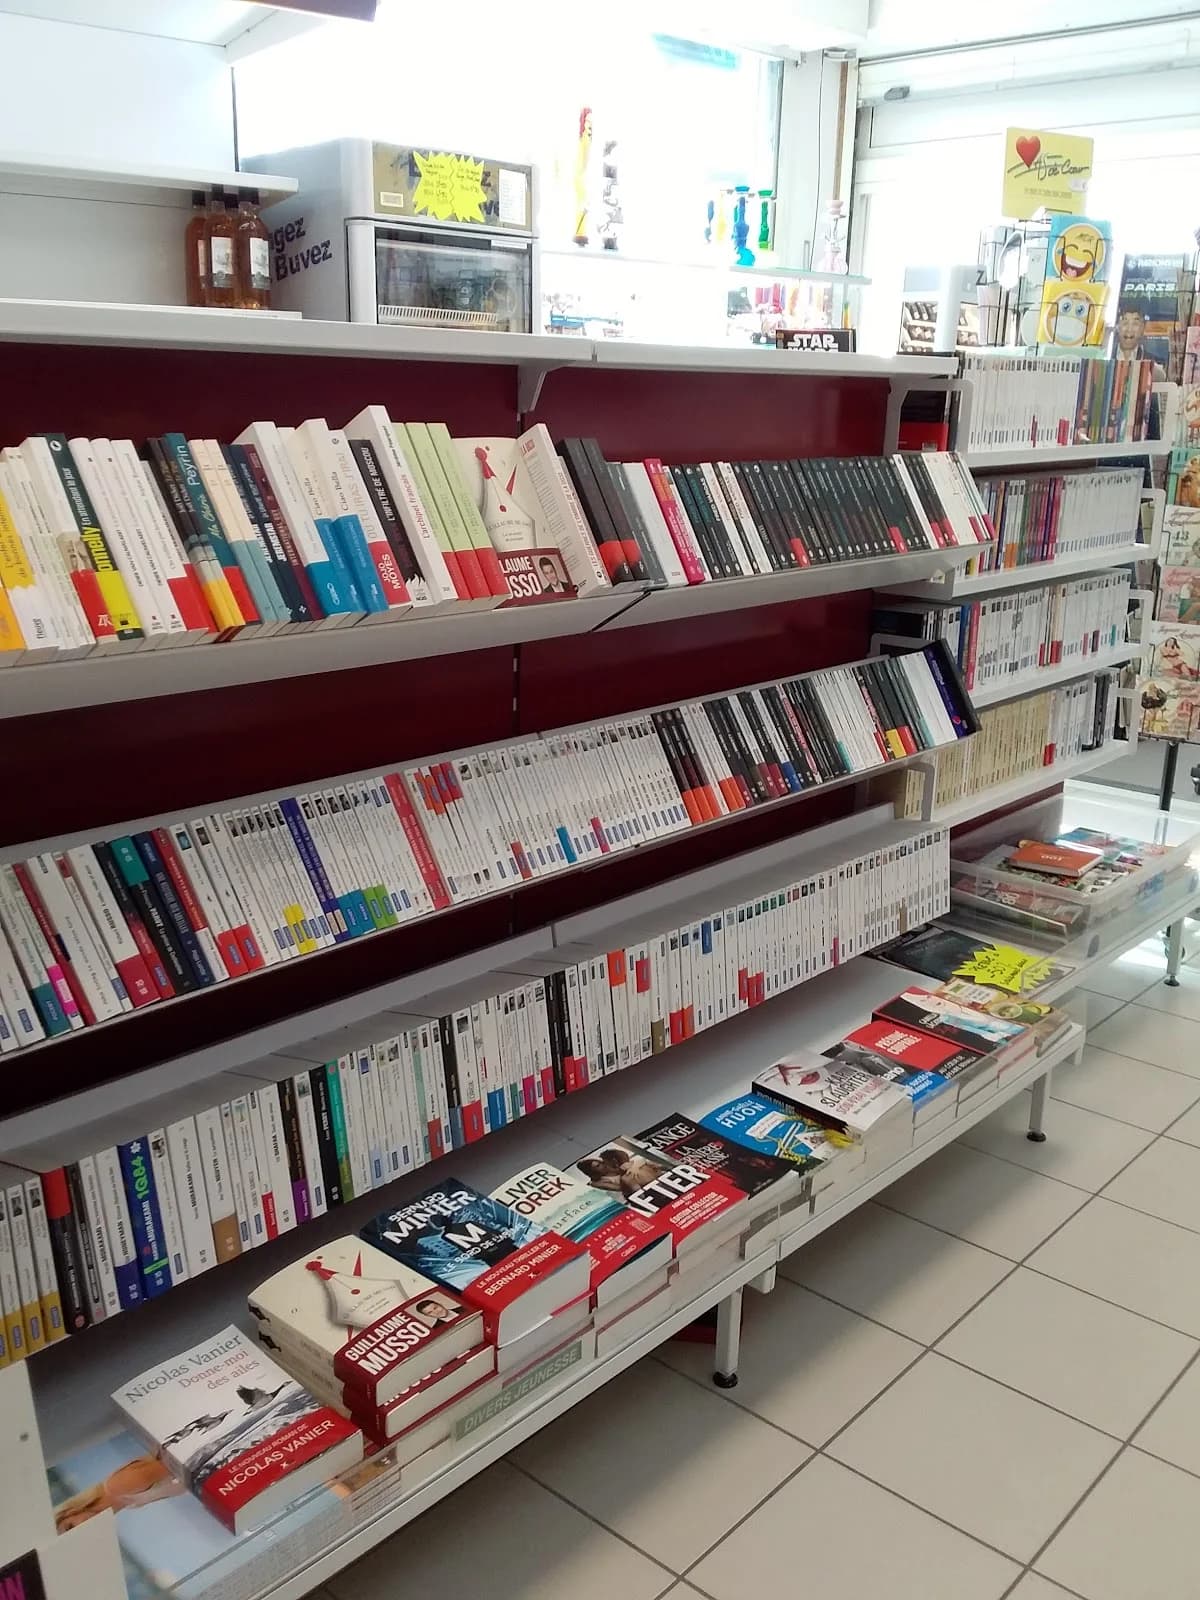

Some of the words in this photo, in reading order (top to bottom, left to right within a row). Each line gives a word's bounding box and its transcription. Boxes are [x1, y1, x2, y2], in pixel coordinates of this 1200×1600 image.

[275, 239, 333, 281] Buvez
[1124, 283, 1177, 292] PARIS
[787, 333, 839, 349] STAR
[60, 465, 74, 481] jour
[175, 443, 201, 486] Peyrin
[361, 445, 378, 476] MOSCOU
[330, 470, 341, 490] Bella
[372, 475, 382, 487] DE
[69, 486, 87, 516] attendant
[337, 490, 349, 511] Ciao
[79, 515, 91, 527] En
[411, 504, 430, 539] L'archipel
[82, 523, 114, 574] onnelly
[501, 554, 534, 573] LAUME
[378, 562, 390, 583] JOJO
[382, 553, 400, 588] MOYES
[820, 1071, 873, 1108] SLAUGHTER
[720, 1102, 768, 1129] HUON
[131, 1155, 148, 1198] 1Q84
[495, 1168, 556, 1208] LIVIER
[389, 1191, 445, 1223] BERNARD
[516, 1177, 575, 1216] OREK
[142, 1200, 155, 1240] MURAKAMI
[381, 1189, 477, 1245] MINIER
[552, 1199, 593, 1231] urface
[445, 1222, 487, 1249] M
[475, 1281, 485, 1289] LE
[484, 1261, 514, 1284] NOUVEAU
[512, 1244, 542, 1266] THRILLER
[540, 1239, 550, 1248] DE
[484, 1263, 531, 1297] BERNARD
[530, 1243, 562, 1270] MINIER
[344, 1311, 412, 1362] GUILLAUME
[358, 1321, 431, 1376] MUSSO
[125, 1363, 190, 1404] Nicolas
[188, 1333, 243, 1367] Vanier
[178, 1349, 250, 1390] Donne-moi
[206, 1374, 230, 1391] des
[231, 1359, 261, 1381] ailes
[464, 1390, 513, 1431] DIVERS
[512, 1348, 578, 1401] JEUNESSE
[218, 1449, 285, 1497] NICOLAS
[284, 1419, 336, 1455] VANIER
[228, 1463, 240, 1475] LE
[239, 1444, 273, 1467] NOUVEAU
[271, 1430, 298, 1449] ROMAN
[297, 1423, 309, 1433] DE
